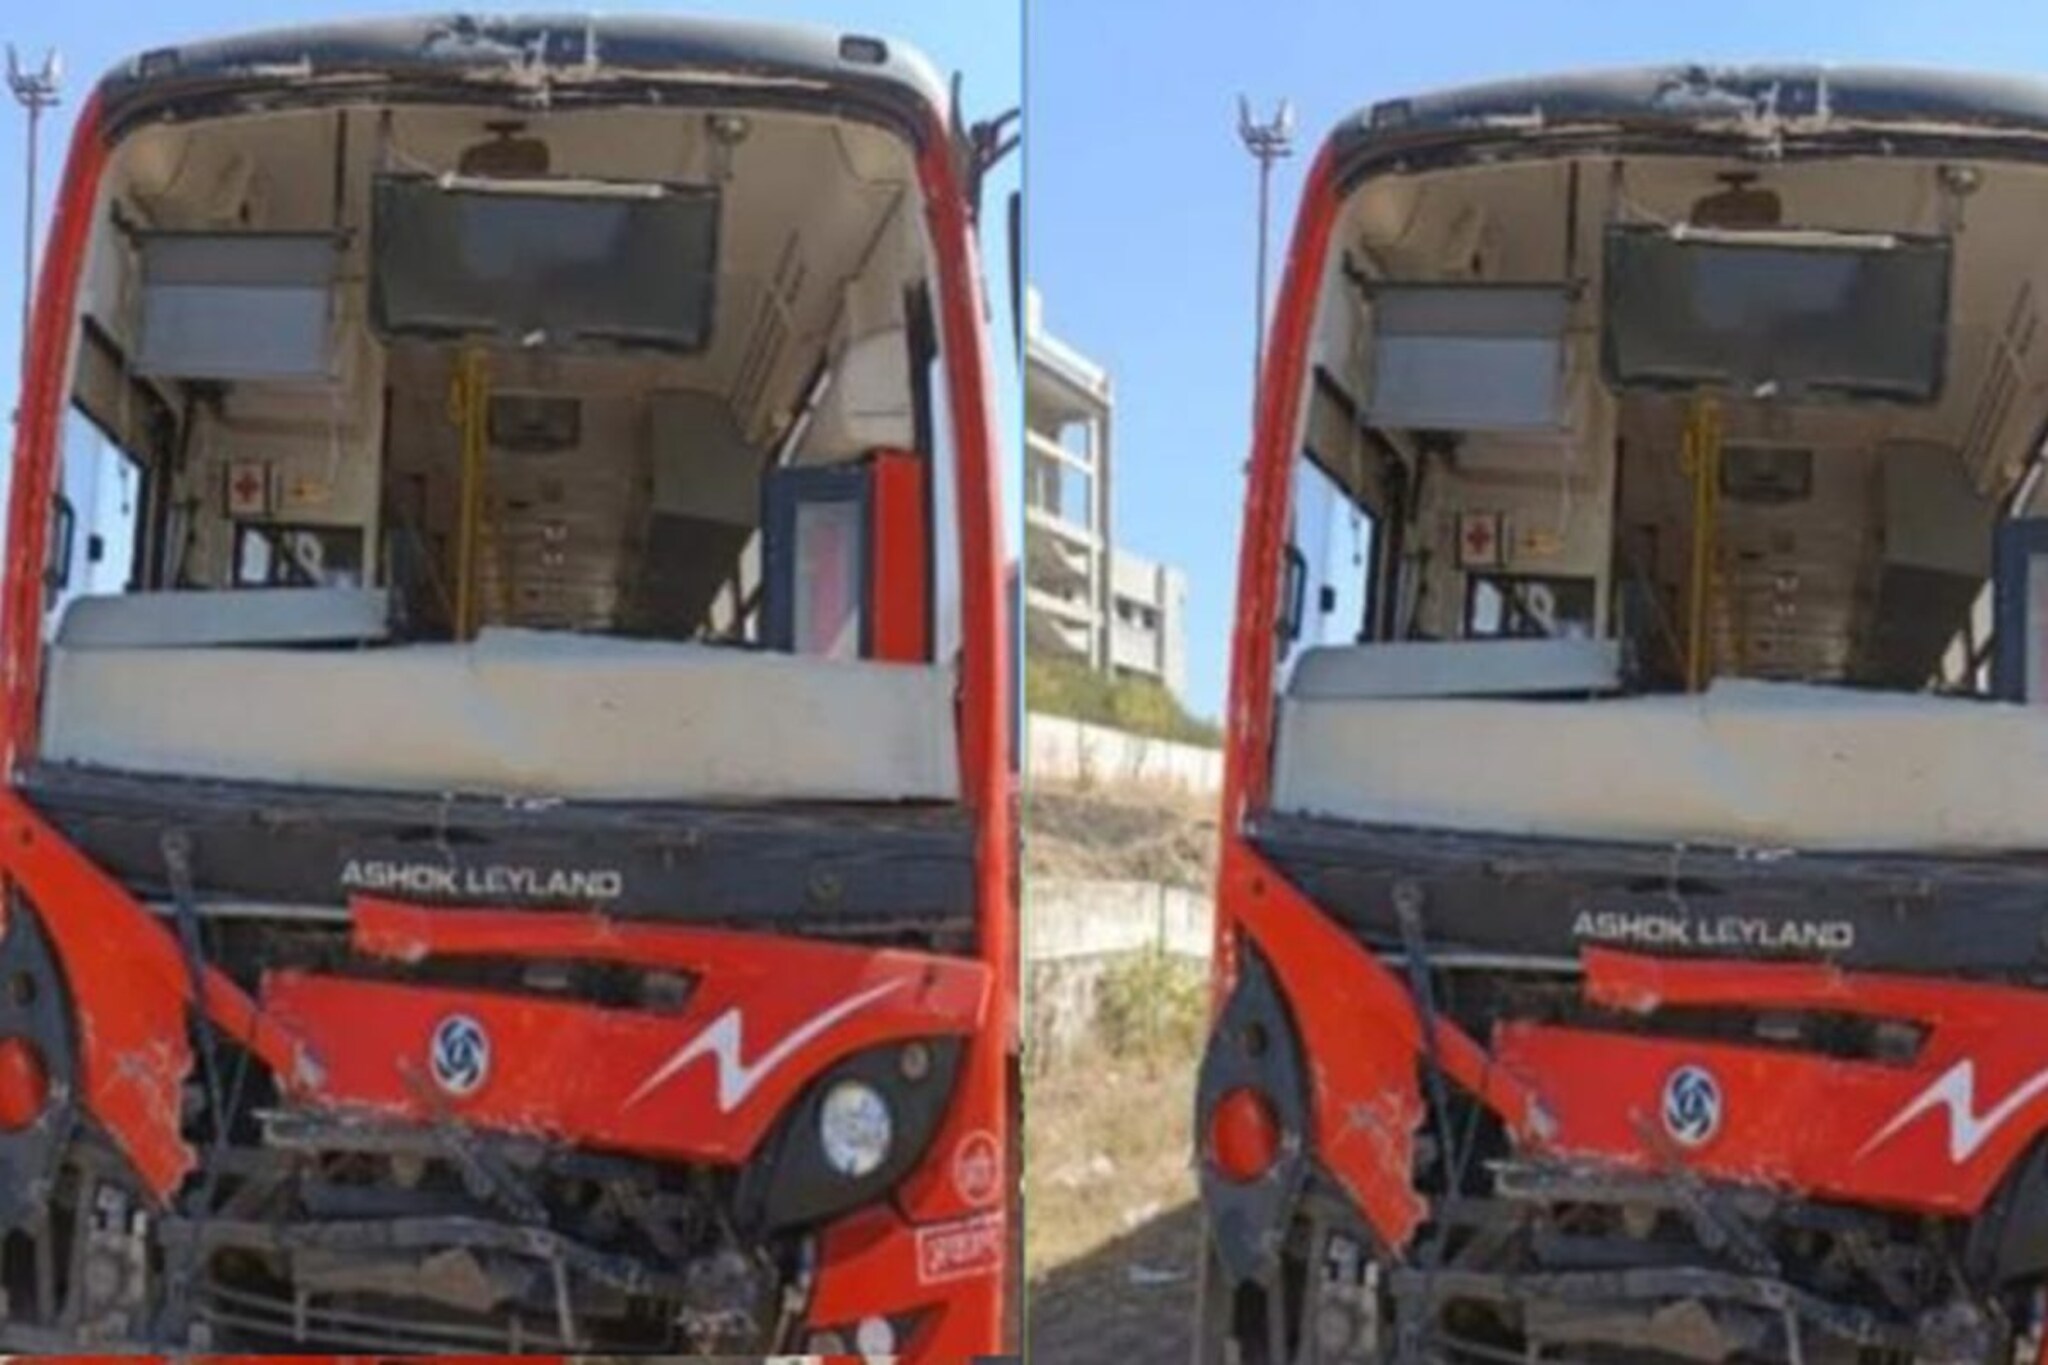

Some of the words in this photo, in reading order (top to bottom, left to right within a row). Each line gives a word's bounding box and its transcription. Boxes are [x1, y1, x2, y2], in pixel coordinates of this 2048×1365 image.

[341, 860, 457, 893] ASHOK
[465, 866, 622, 898] LEYLAND
[1573, 910, 1689, 944] ASHOK
[1697, 916, 1854, 947] LEYLAND
